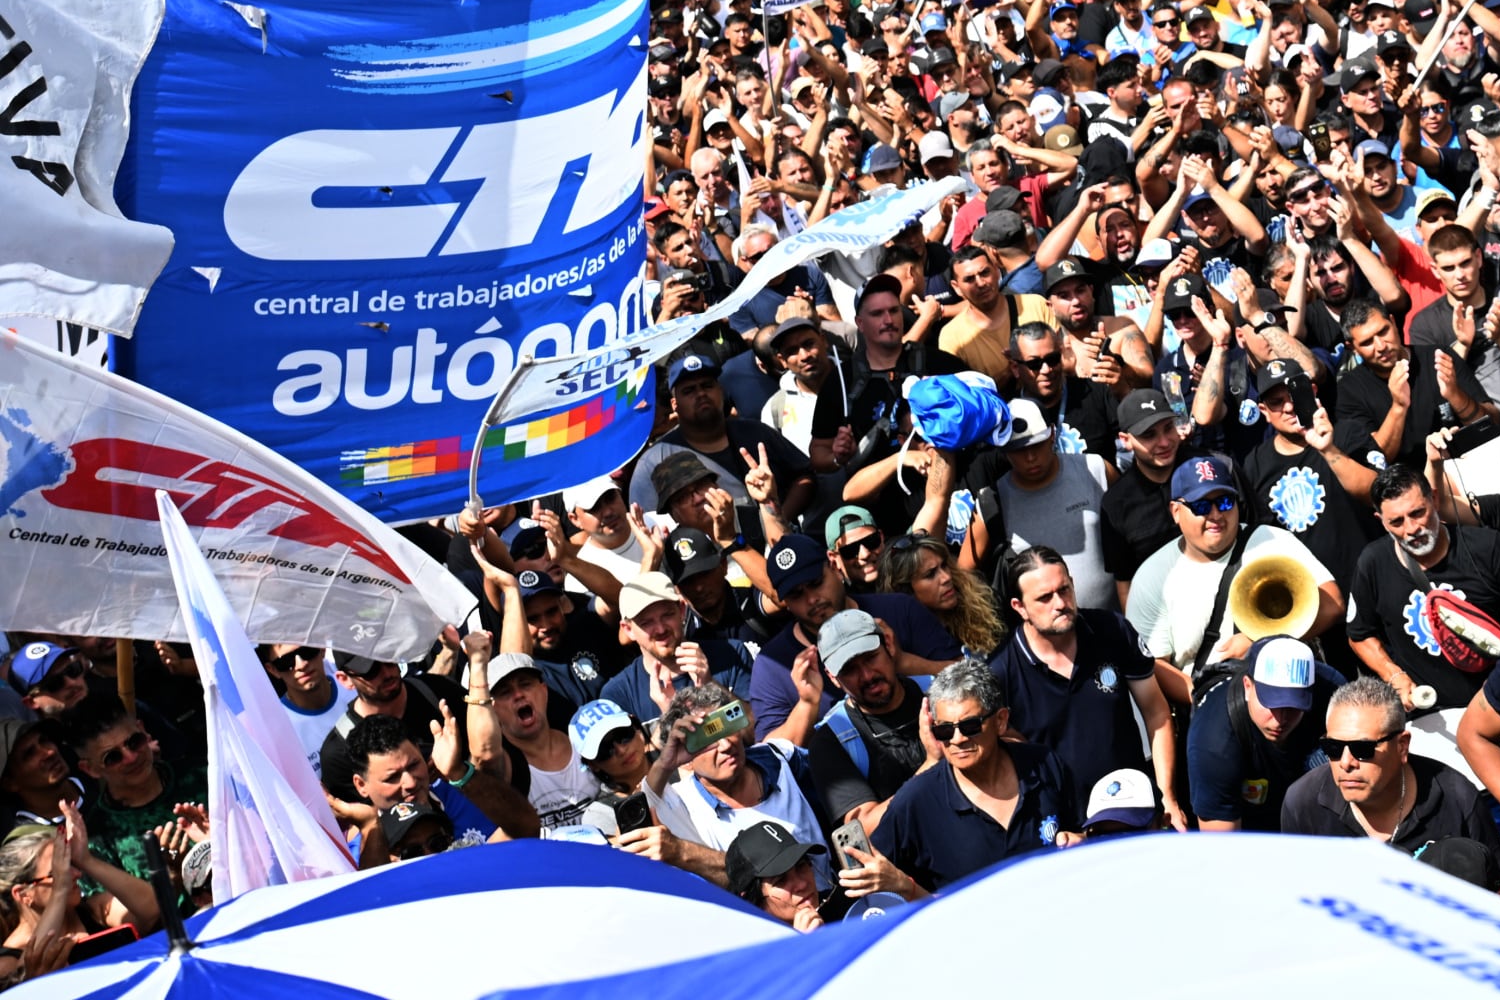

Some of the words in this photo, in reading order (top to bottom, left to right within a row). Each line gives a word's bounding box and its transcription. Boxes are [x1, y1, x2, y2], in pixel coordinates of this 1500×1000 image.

[253, 290, 360, 316] central
[368, 290, 406, 313] de
[414, 256, 605, 311] trabajadores/as
[609, 236, 626, 263] de
[626, 223, 637, 250] la
[8, 527, 67, 547] Central
[69, 534, 90, 549] de
[206, 547, 299, 572] Trabajadoras
[299, 561, 319, 575] de
[319, 565, 335, 578] la
